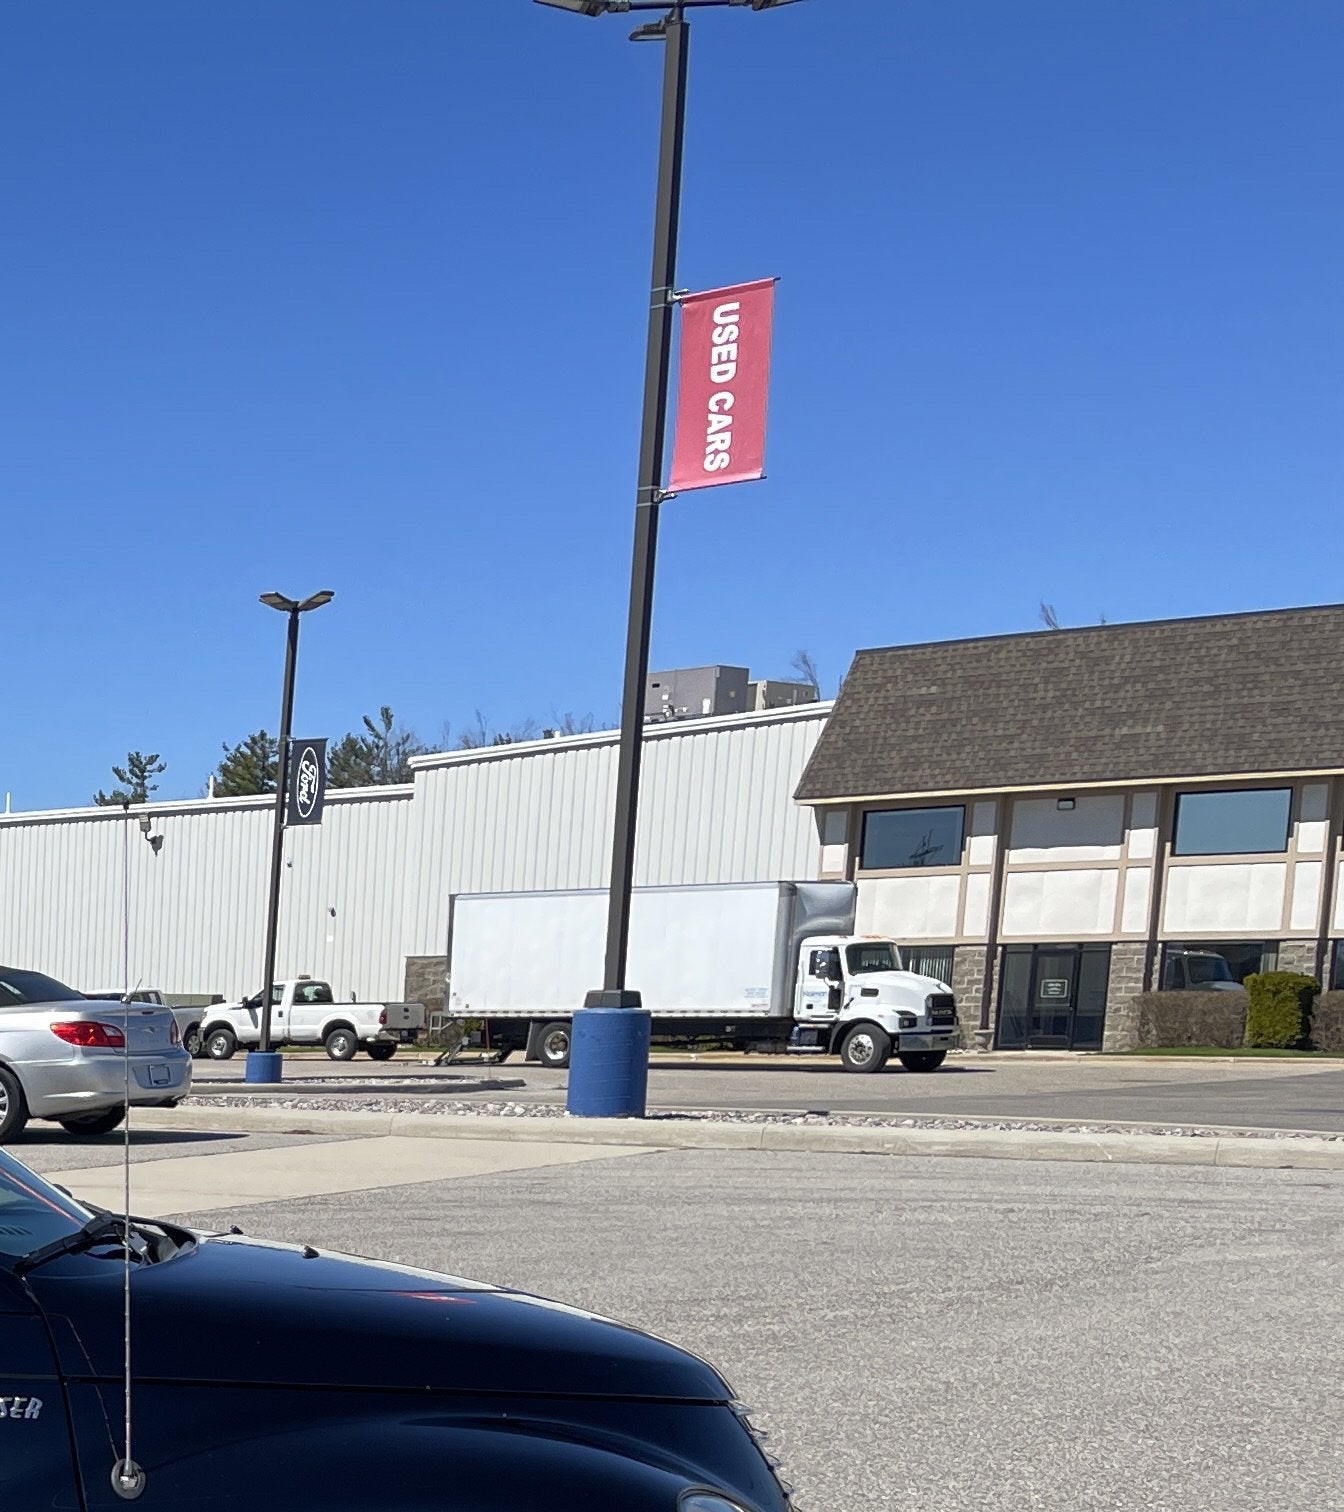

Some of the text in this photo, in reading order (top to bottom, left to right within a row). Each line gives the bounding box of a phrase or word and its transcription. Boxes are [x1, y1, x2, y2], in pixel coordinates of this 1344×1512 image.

[704, 302, 741, 472] USED CARS
[299, 760, 317, 805] Ford
